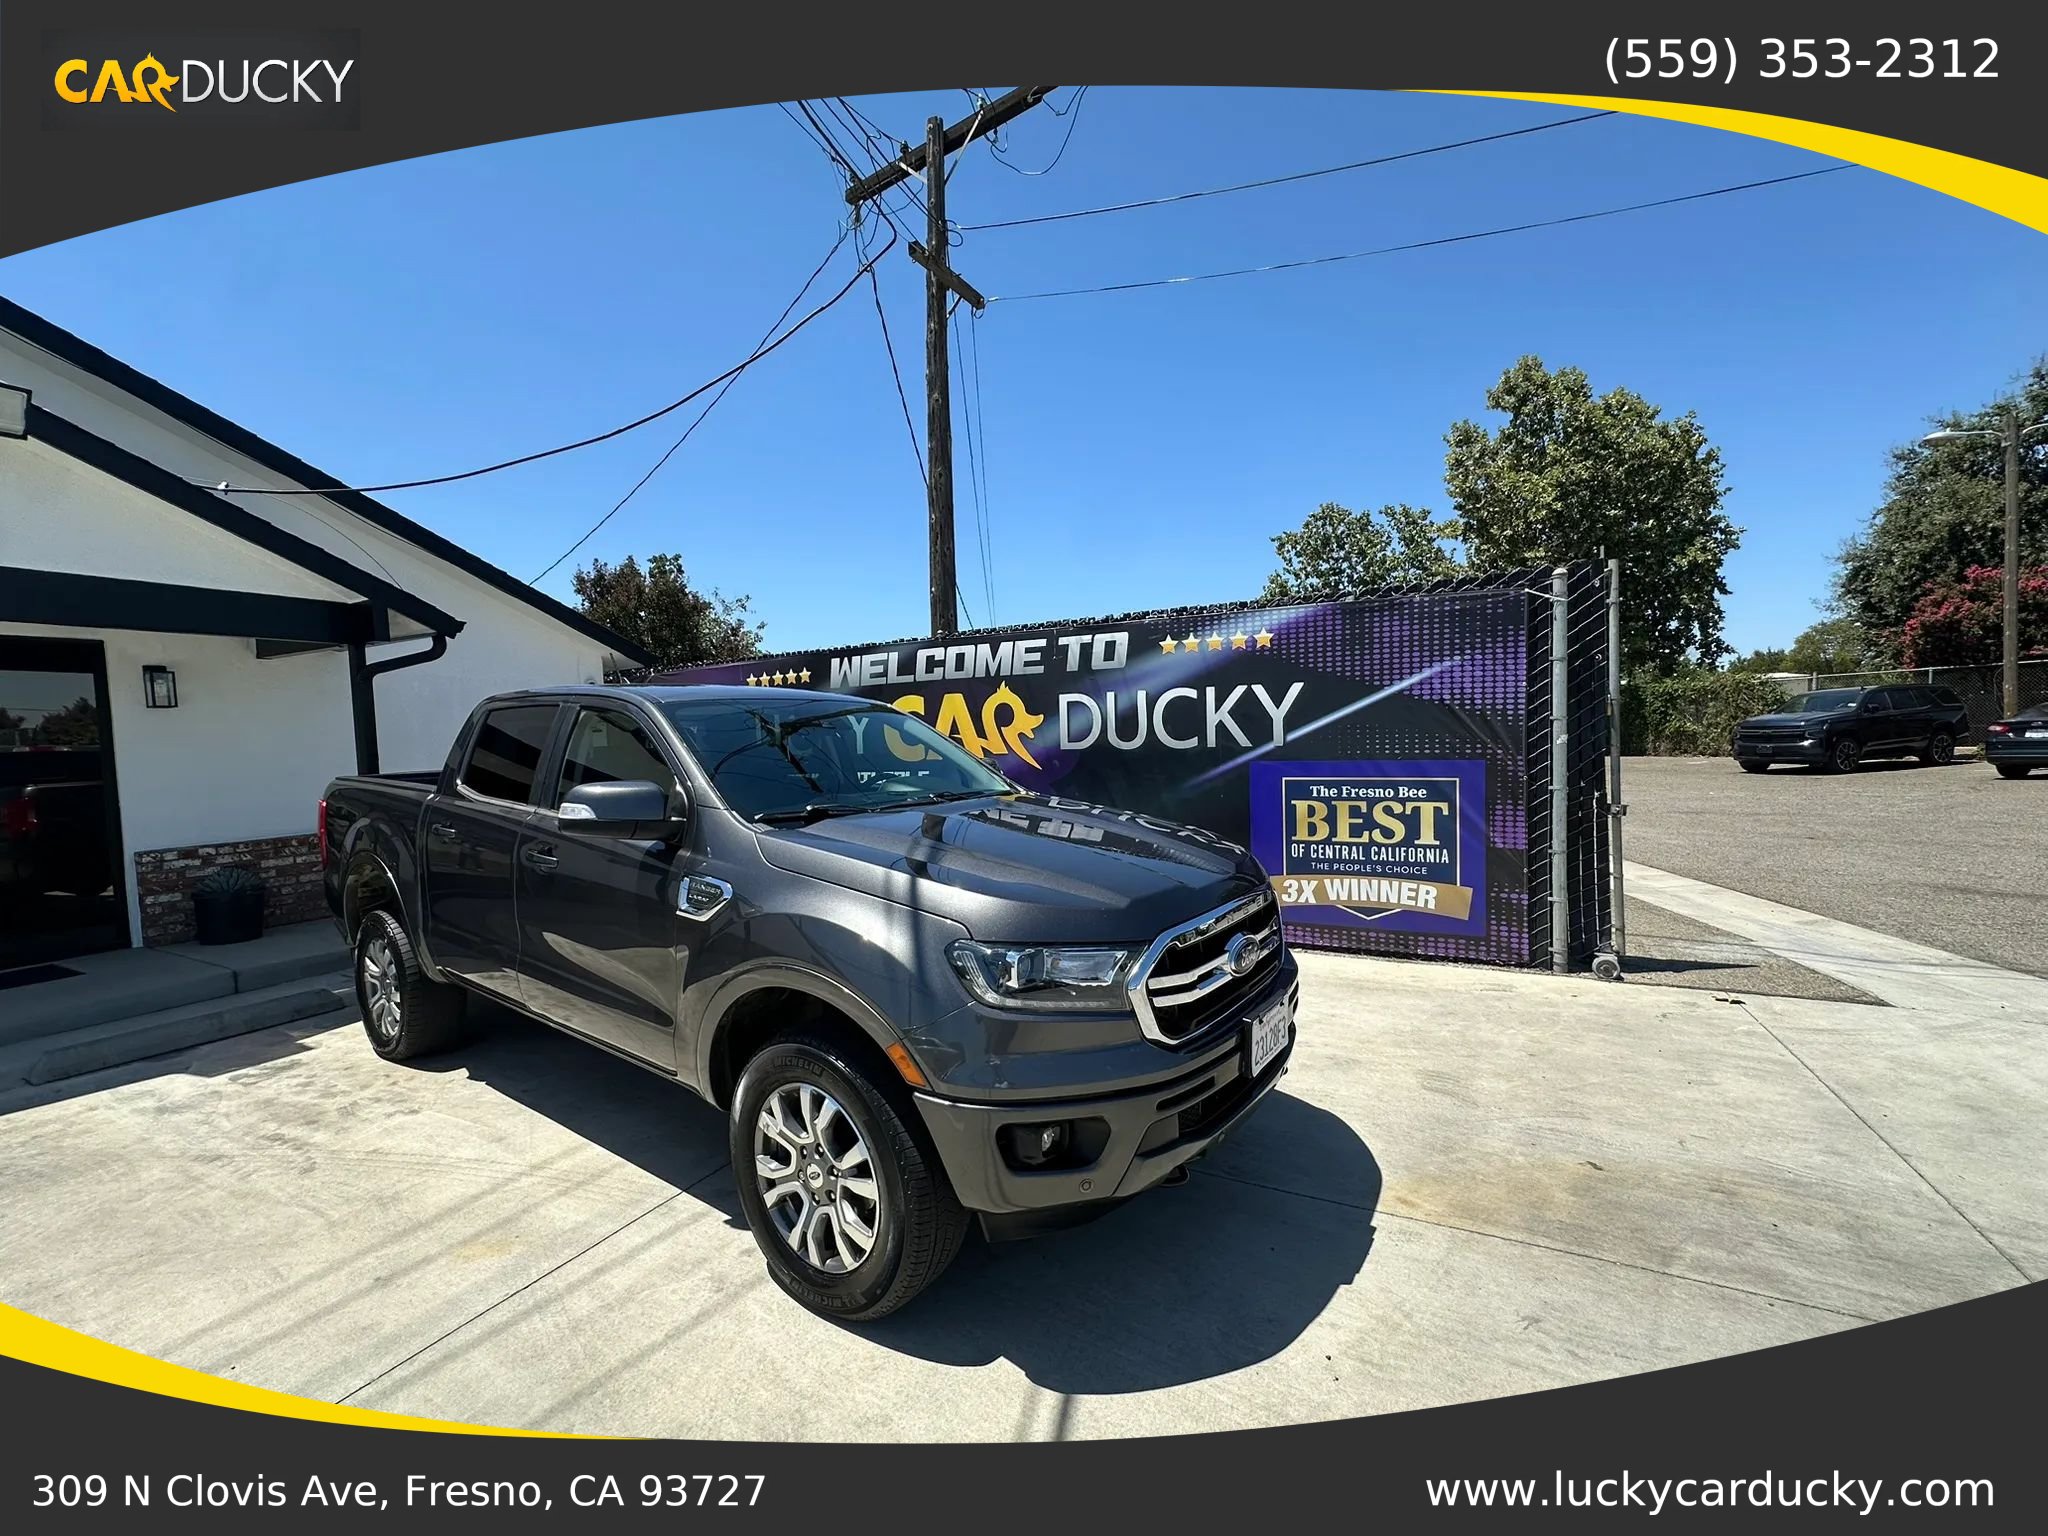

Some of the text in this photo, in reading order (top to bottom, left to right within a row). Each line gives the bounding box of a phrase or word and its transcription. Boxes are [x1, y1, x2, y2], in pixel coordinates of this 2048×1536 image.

[830, 631, 1129, 688] WELCOME TO
[1058, 682, 1305, 750] DUCKY
[1310, 785, 1427, 798] The Fresno Bee
[1291, 800, 1449, 845] BEST
[1291, 844, 1449, 864] OF CENTRAL CALIFORNIA
[1311, 862, 1428, 875] THE PEOPLE'S CHOICE
[1281, 878, 1439, 909] 3X WINNER
